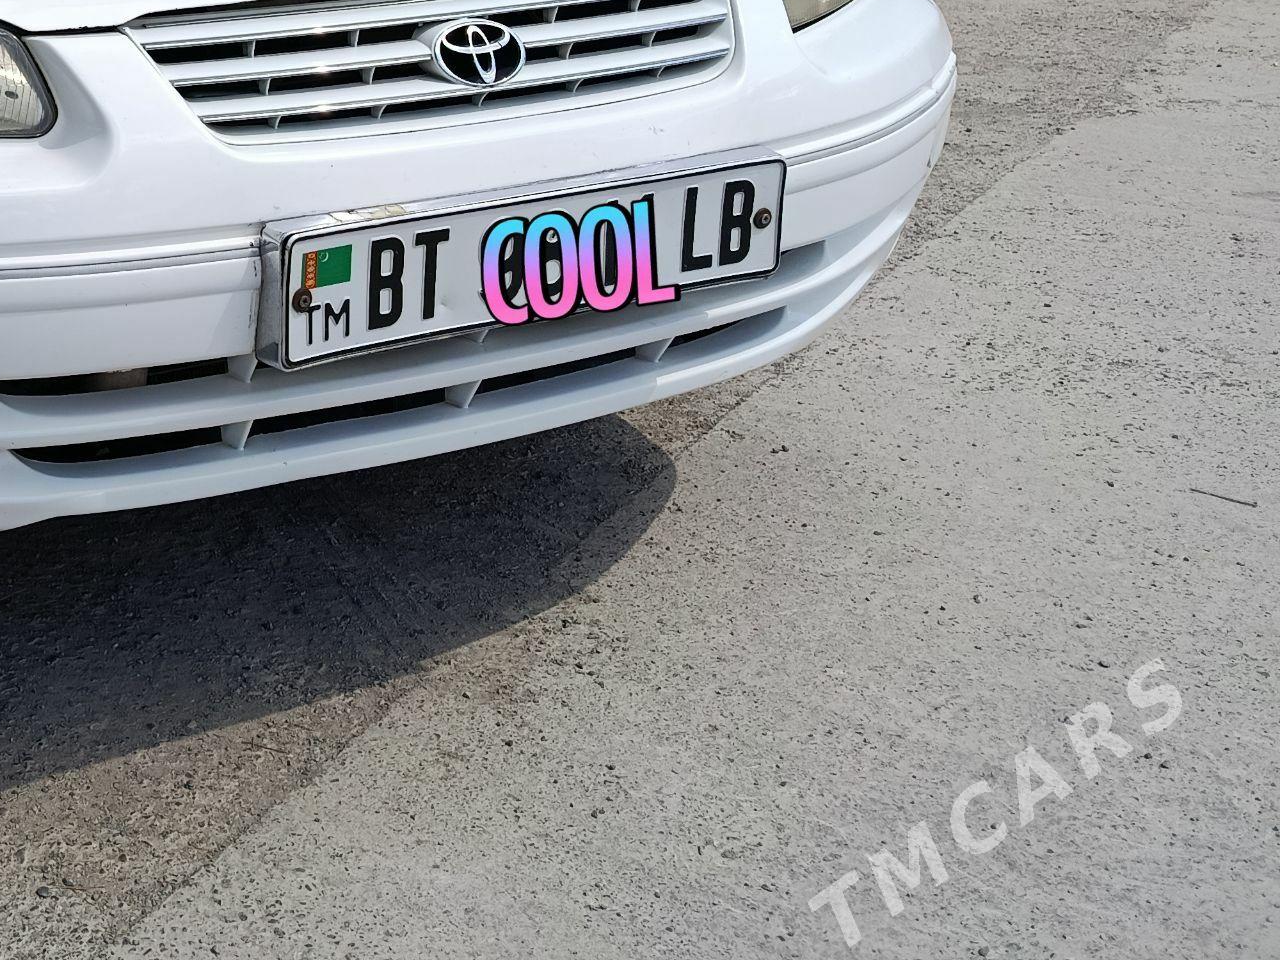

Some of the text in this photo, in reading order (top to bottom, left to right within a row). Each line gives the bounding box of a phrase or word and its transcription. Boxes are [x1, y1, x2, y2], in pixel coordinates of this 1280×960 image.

[368, 227, 451, 331] BT
[681, 179, 756, 273] LB
[302, 298, 351, 346] TM
